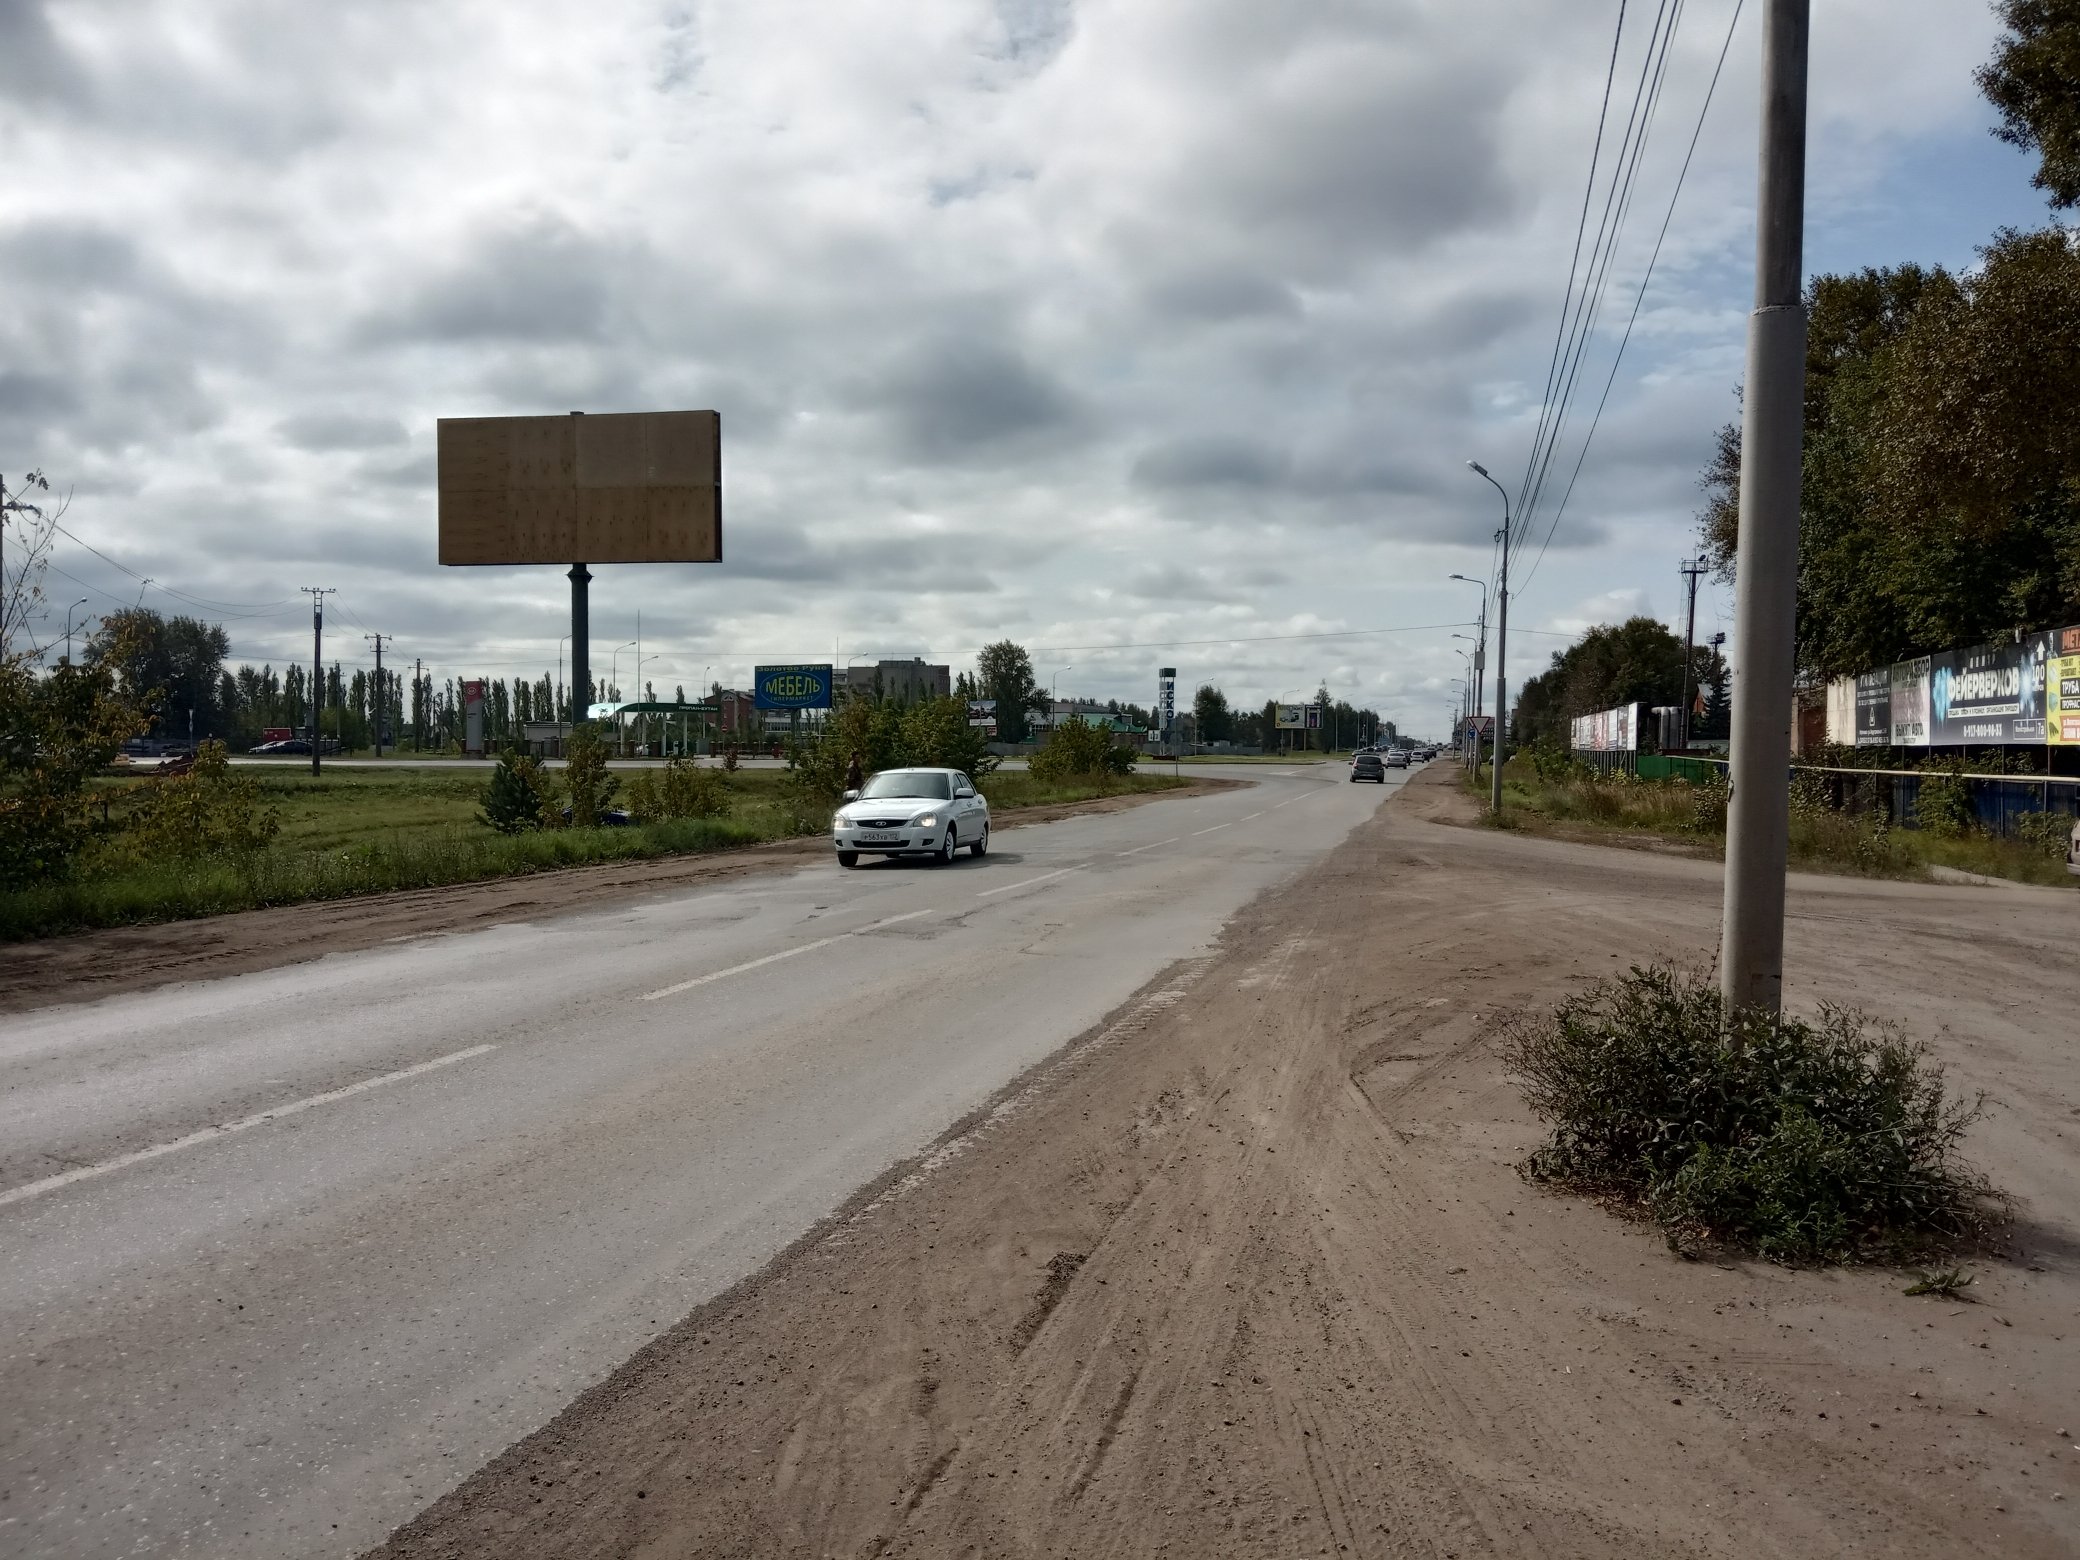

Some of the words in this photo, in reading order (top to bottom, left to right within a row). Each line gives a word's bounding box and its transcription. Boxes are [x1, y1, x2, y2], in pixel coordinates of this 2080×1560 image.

[765, 675, 821, 696] МЕБЕЛЬ
[1946, 667, 2020, 702] ФЕЙЕРВЕРКОВ
[2062, 680, 2080, 694] ТРУБА
